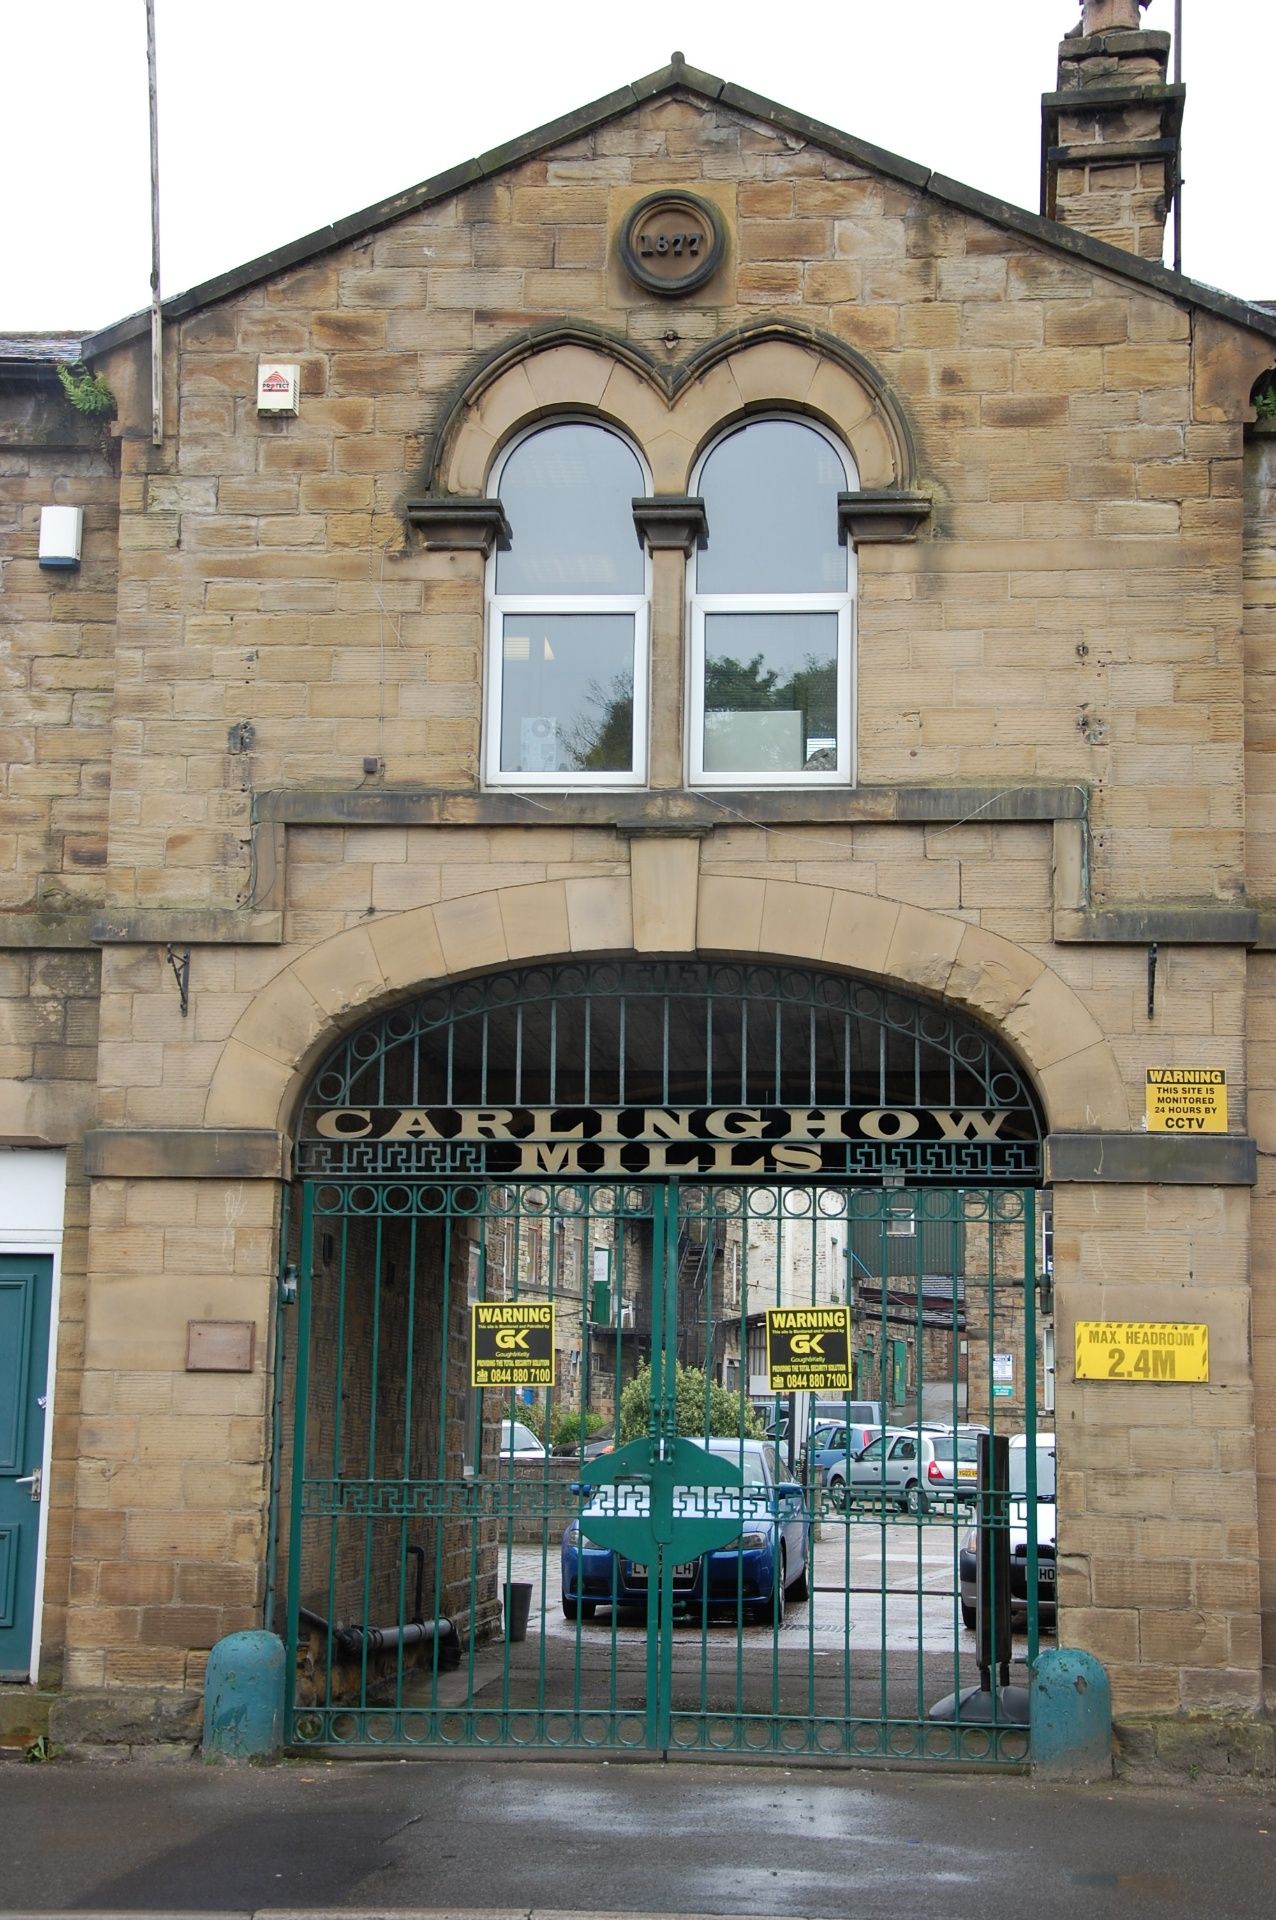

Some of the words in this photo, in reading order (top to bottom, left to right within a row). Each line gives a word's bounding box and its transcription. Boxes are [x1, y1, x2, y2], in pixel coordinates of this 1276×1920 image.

[640, 233, 703, 256] 1877
[1149, 1070, 1222, 1083] WARNING
[316, 1108, 1008, 1141] CARLINGHOW
[1165, 1117, 1204, 1129] CCTV
[511, 1142, 823, 1174] MILLS
[479, 1308, 550, 1323] WARNING
[772, 1312, 845, 1328] WARNING
[495, 1329, 529, 1349] GK
[790, 1334, 825, 1353] GK
[1089, 1330, 1120, 1344] MAX.
[1126, 1331, 1194, 1346] HEADROOM
[1108, 1348, 1176, 1379] 2.4M
[491, 1368, 511, 1382] 0844
[513, 1368, 528, 1382] 880
[530, 1368, 550, 1382] 7100
[787, 1374, 807, 1388] 0844
[809, 1374, 824, 1387] 880
[826, 1373, 847, 1387] 7100
